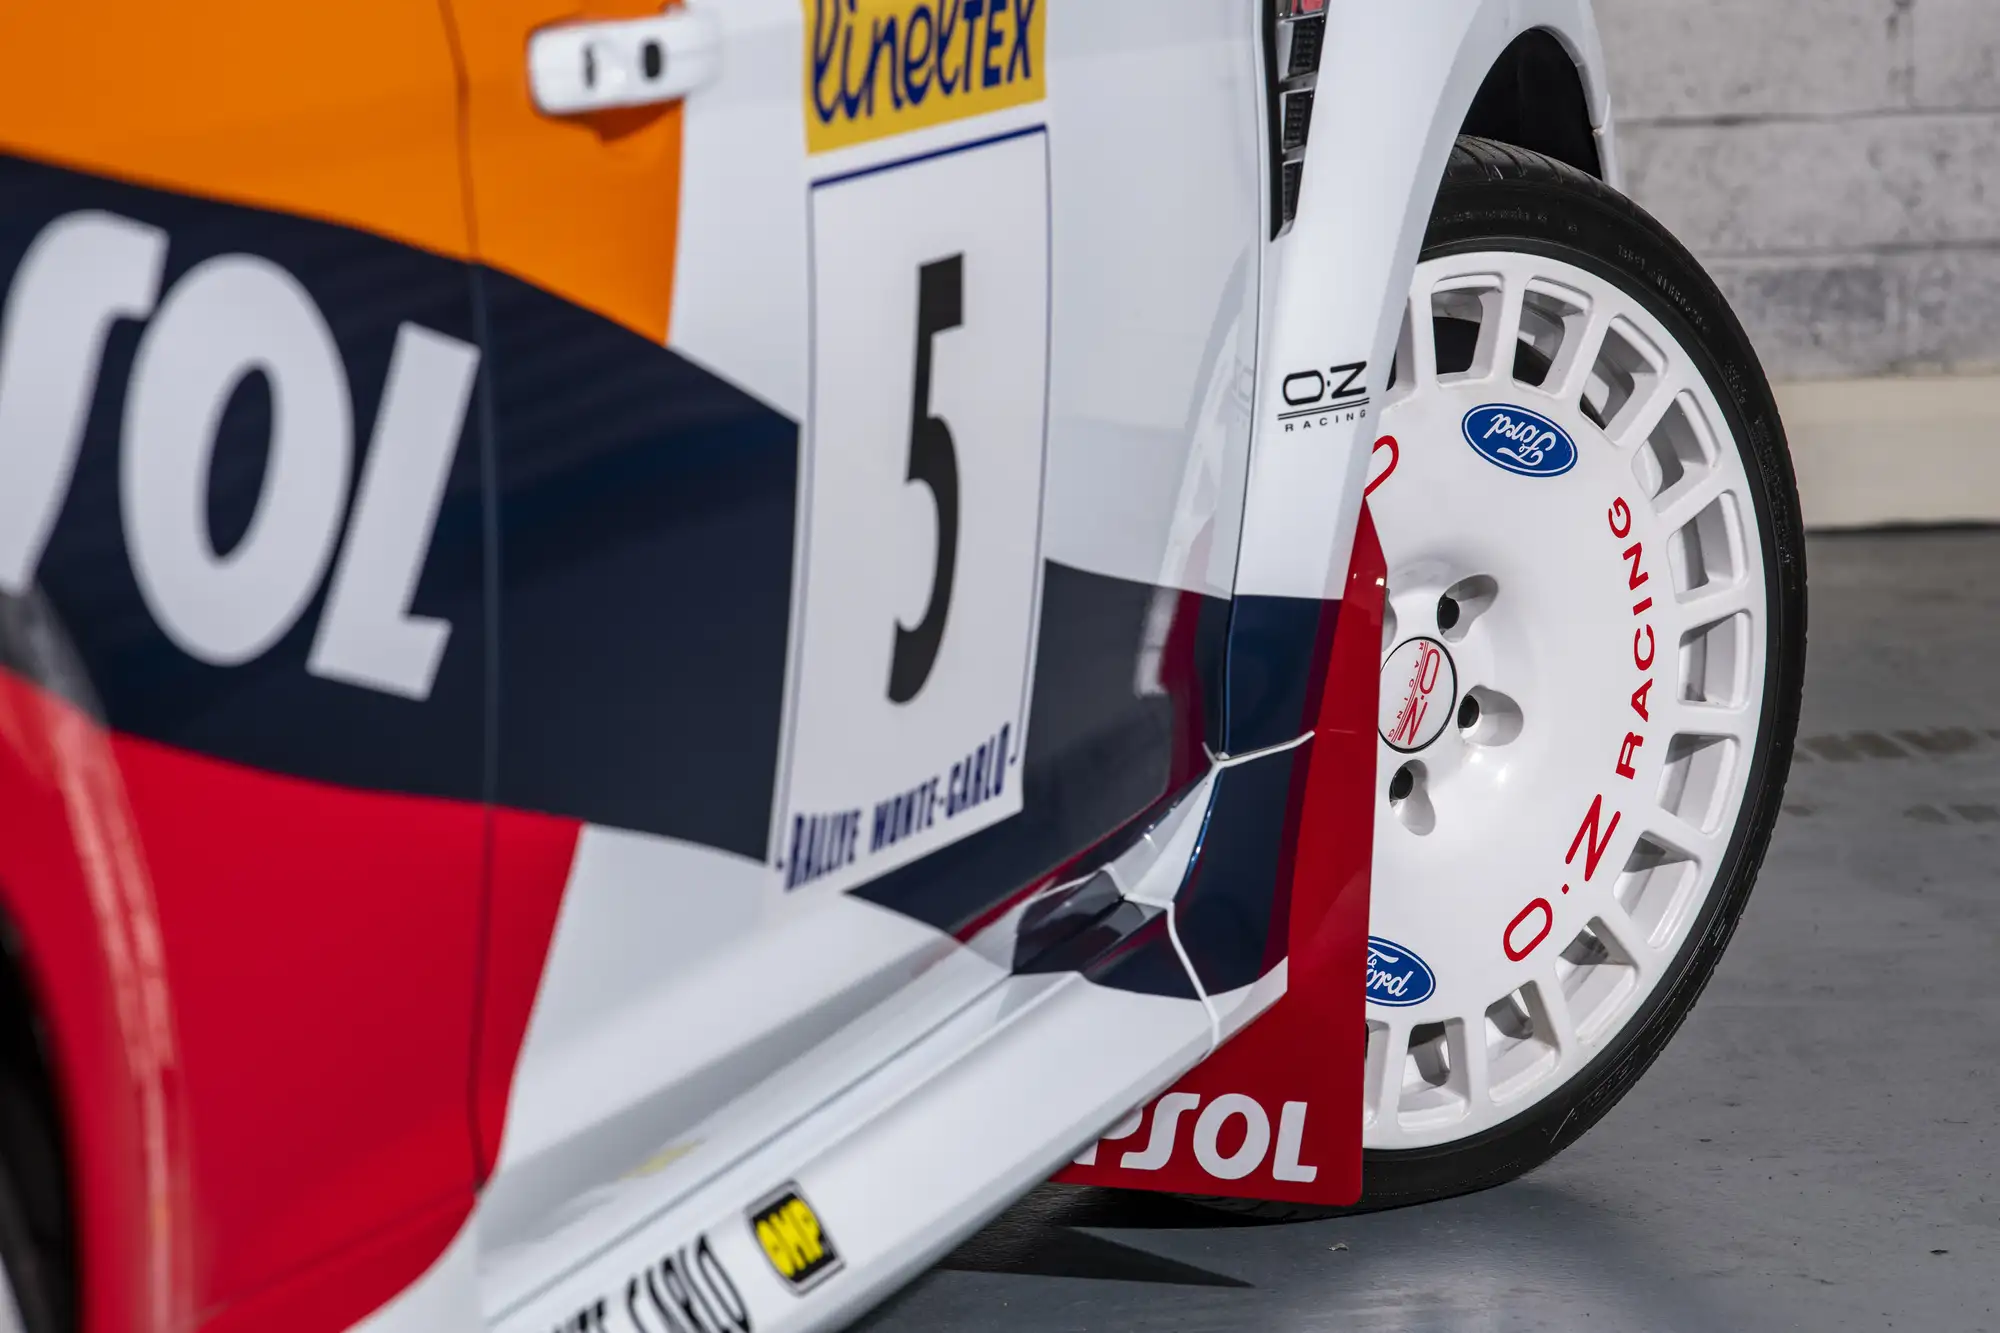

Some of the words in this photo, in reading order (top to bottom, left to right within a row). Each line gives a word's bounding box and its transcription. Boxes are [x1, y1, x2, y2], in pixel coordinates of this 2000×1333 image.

[1284, 409, 1366, 432] RACING
[1483, 413, 1557, 467] Ford
[885, 250, 964, 706] 5
[1608, 496, 1655, 780] RACING
[1388, 642, 1424, 738] RACING
[785, 810, 863, 891] RALLYE
[756, 1198, 823, 1279] OMP
